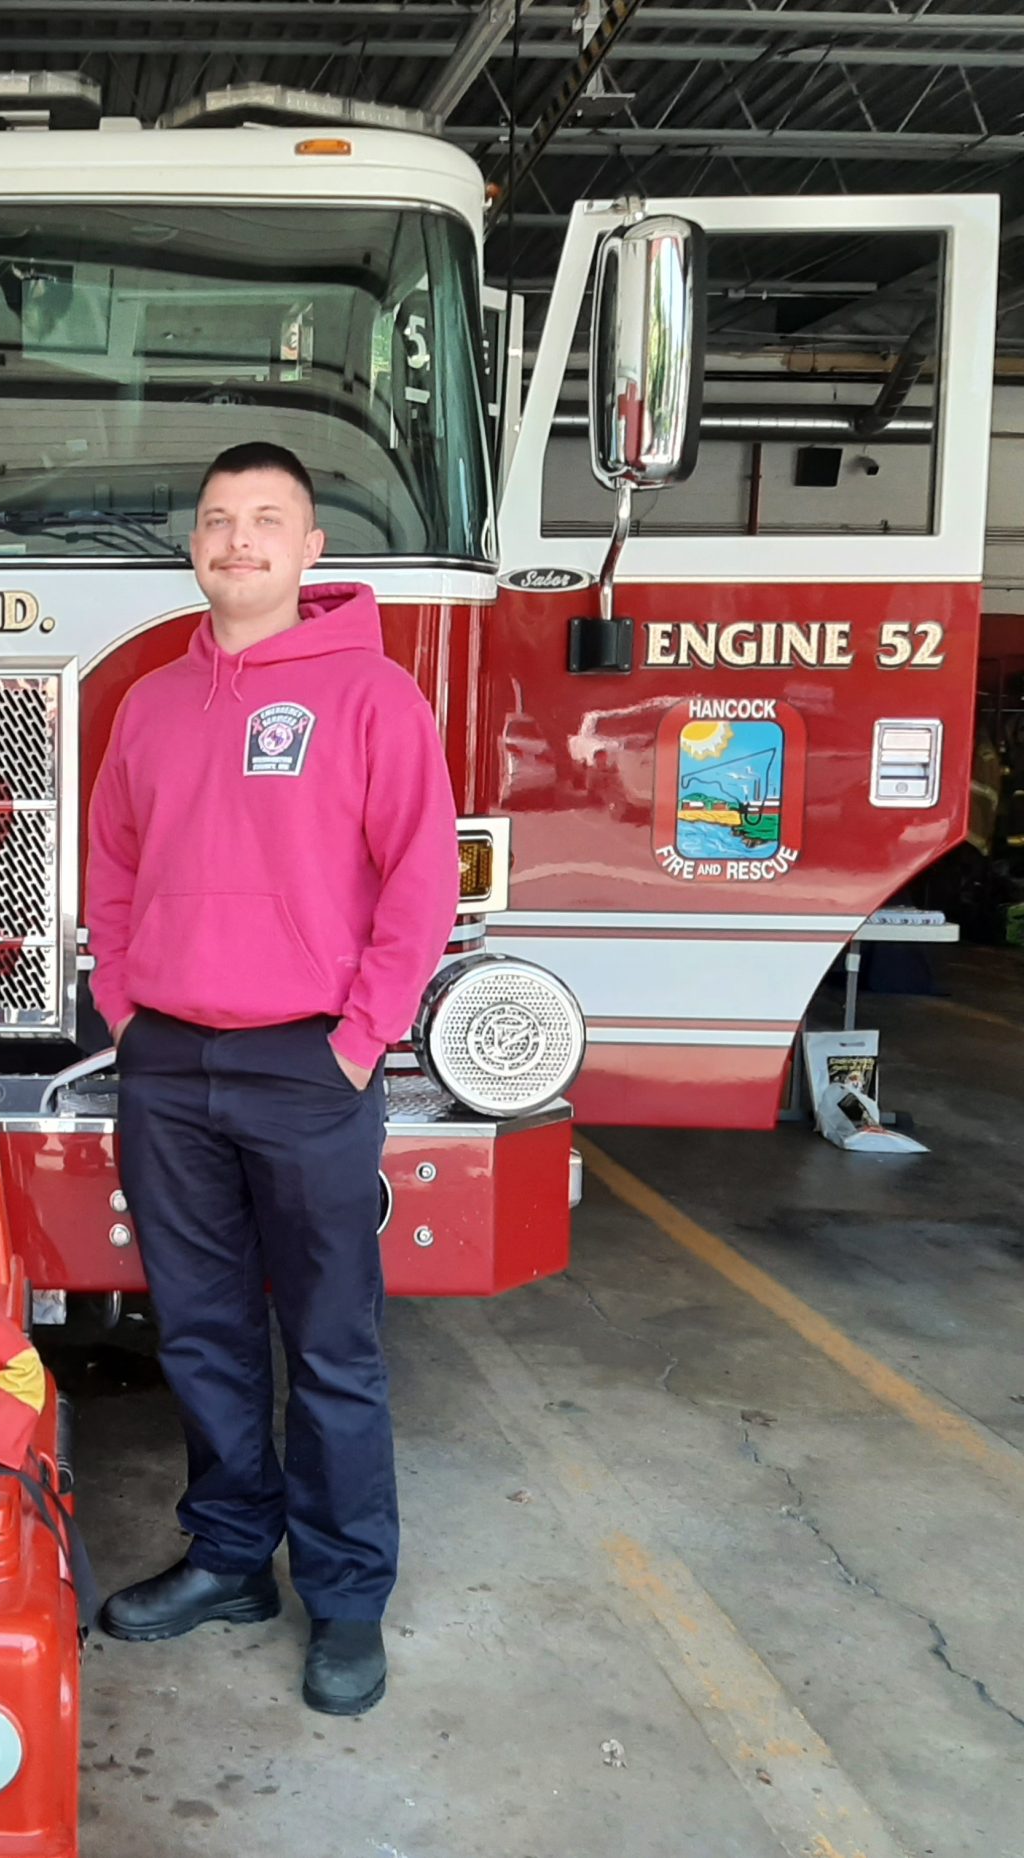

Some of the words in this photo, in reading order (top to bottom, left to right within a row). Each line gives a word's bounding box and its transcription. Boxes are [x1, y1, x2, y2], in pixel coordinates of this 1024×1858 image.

[641, 621, 854, 669] ENGINE
[875, 621, 946, 669] 52
[689, 700, 777, 719] HANCOCK
[655, 845, 695, 879] FIRE
[697, 864, 722, 876] AND
[727, 845, 798, 880] RESCUE
